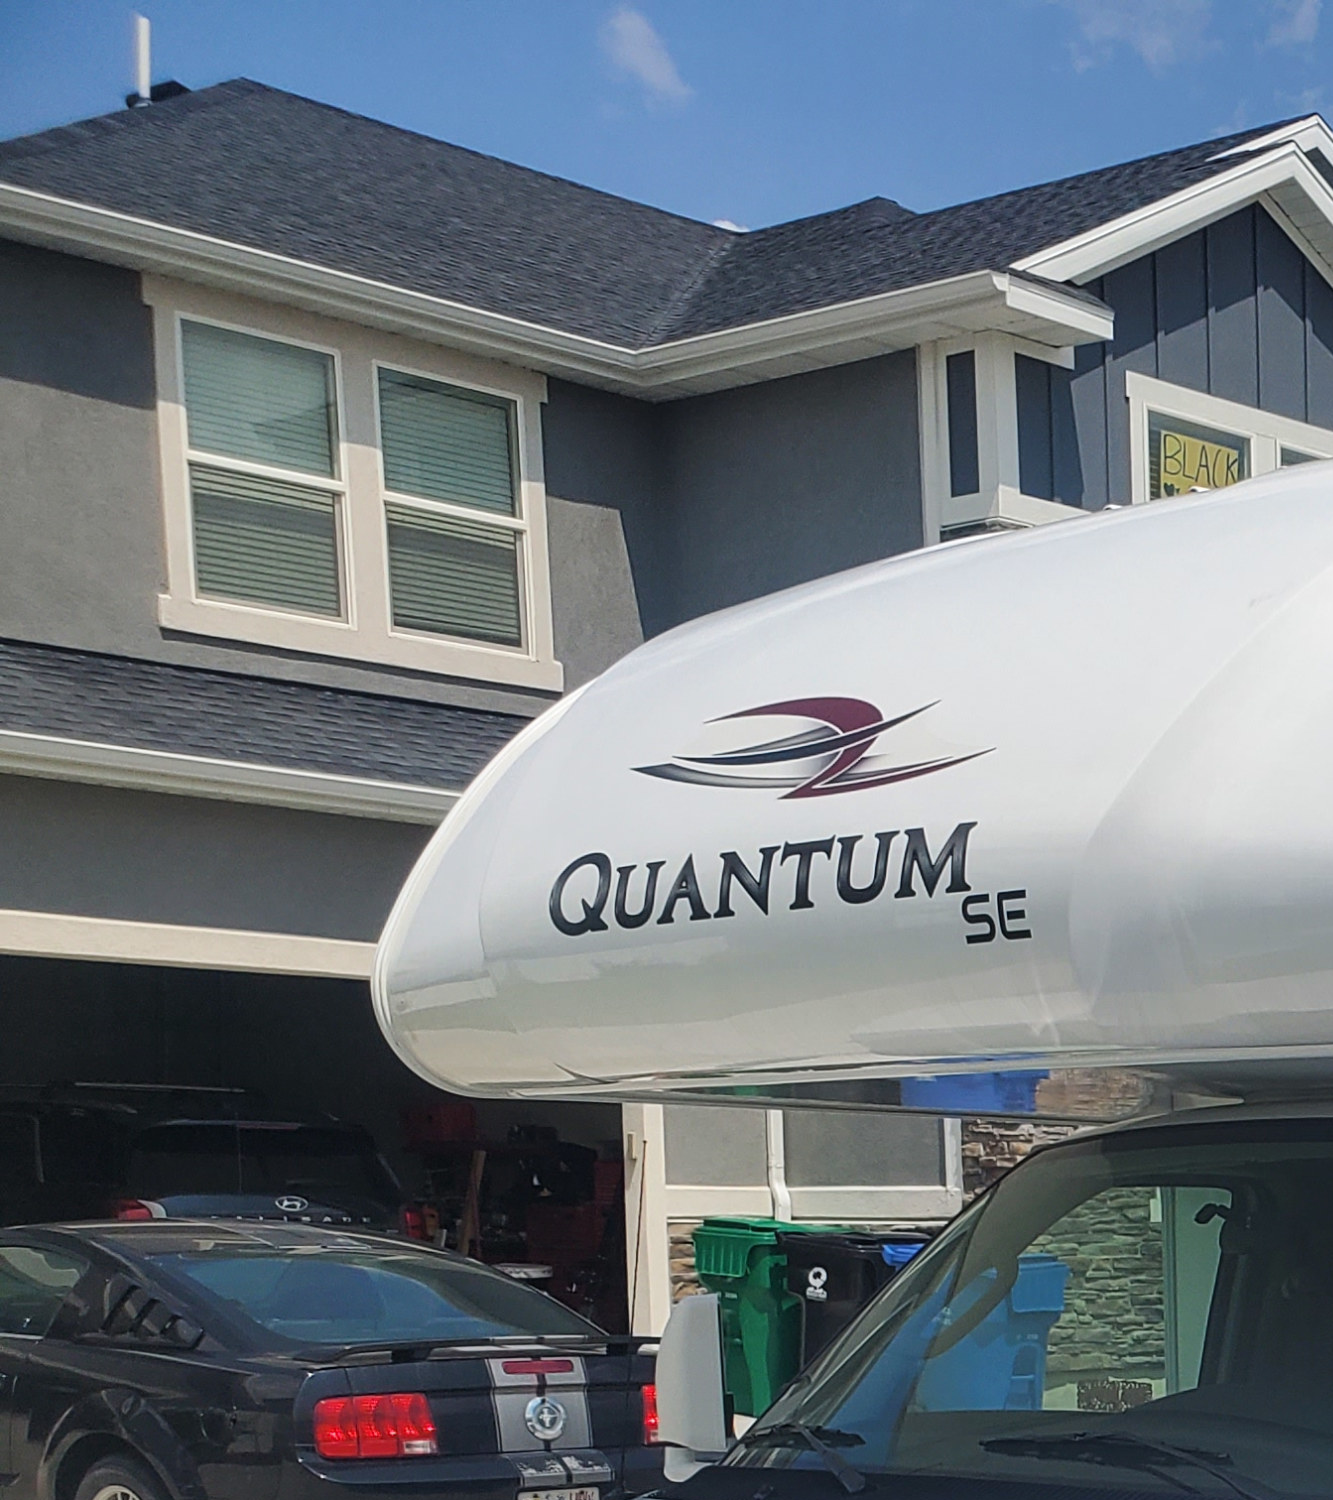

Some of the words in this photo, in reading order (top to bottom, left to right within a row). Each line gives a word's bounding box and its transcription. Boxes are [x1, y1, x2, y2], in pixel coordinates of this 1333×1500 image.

[1163, 433, 1238, 489] BLACK
[549, 821, 978, 936] QUANTUM
[961, 889, 1033, 945] SE
